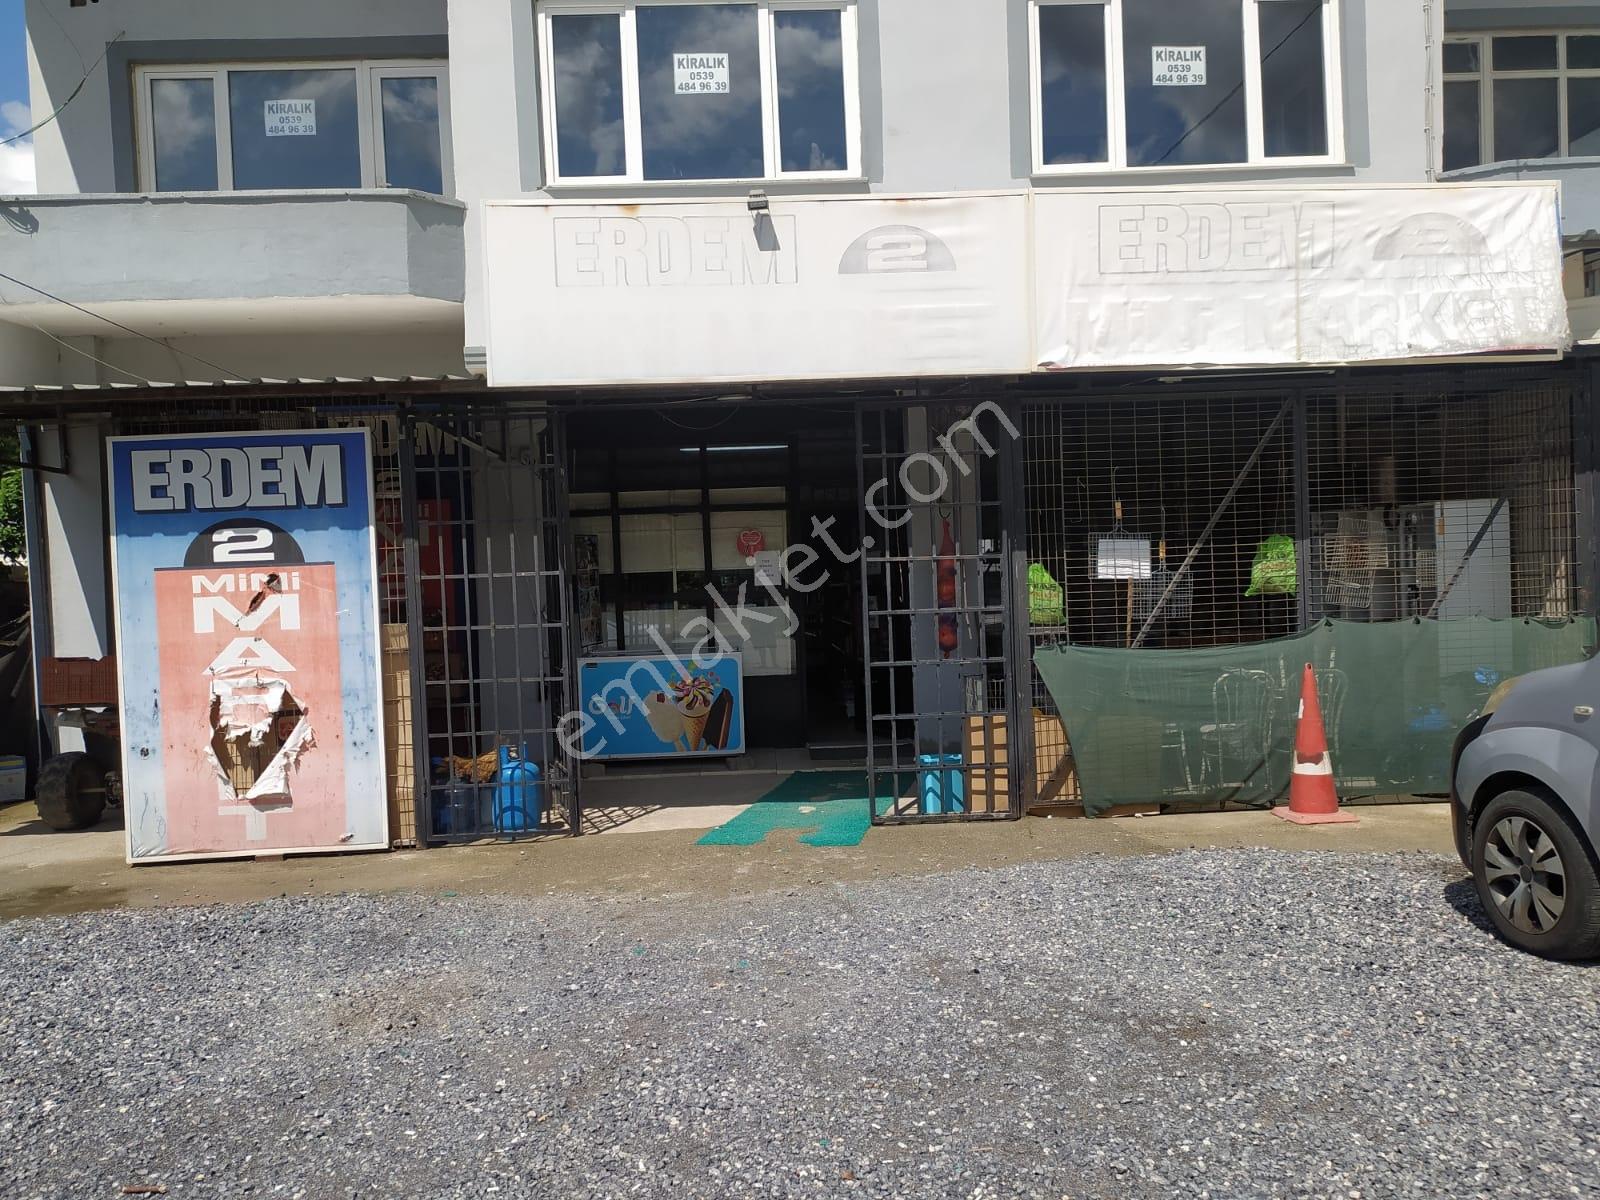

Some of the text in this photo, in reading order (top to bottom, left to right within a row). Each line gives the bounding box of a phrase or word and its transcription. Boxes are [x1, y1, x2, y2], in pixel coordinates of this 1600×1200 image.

[1155, 48, 1202, 61] KİRALIK
[678, 55, 725, 69] KİRALIK
[1167, 64, 1192, 73] 0539
[690, 71, 714, 80] 0539
[1155, 74, 1203, 83] 484 96 39
[678, 82, 727, 91] 484 96 39
[267, 101, 312, 114] KİRALIK
[279, 115, 301, 124] 0539
[1098, 201, 1336, 274] ERDEM
[553, 214, 928, 287] ERDEM 2
[131, 444, 345, 512] ERDEM
[212, 527, 275, 563] 2
